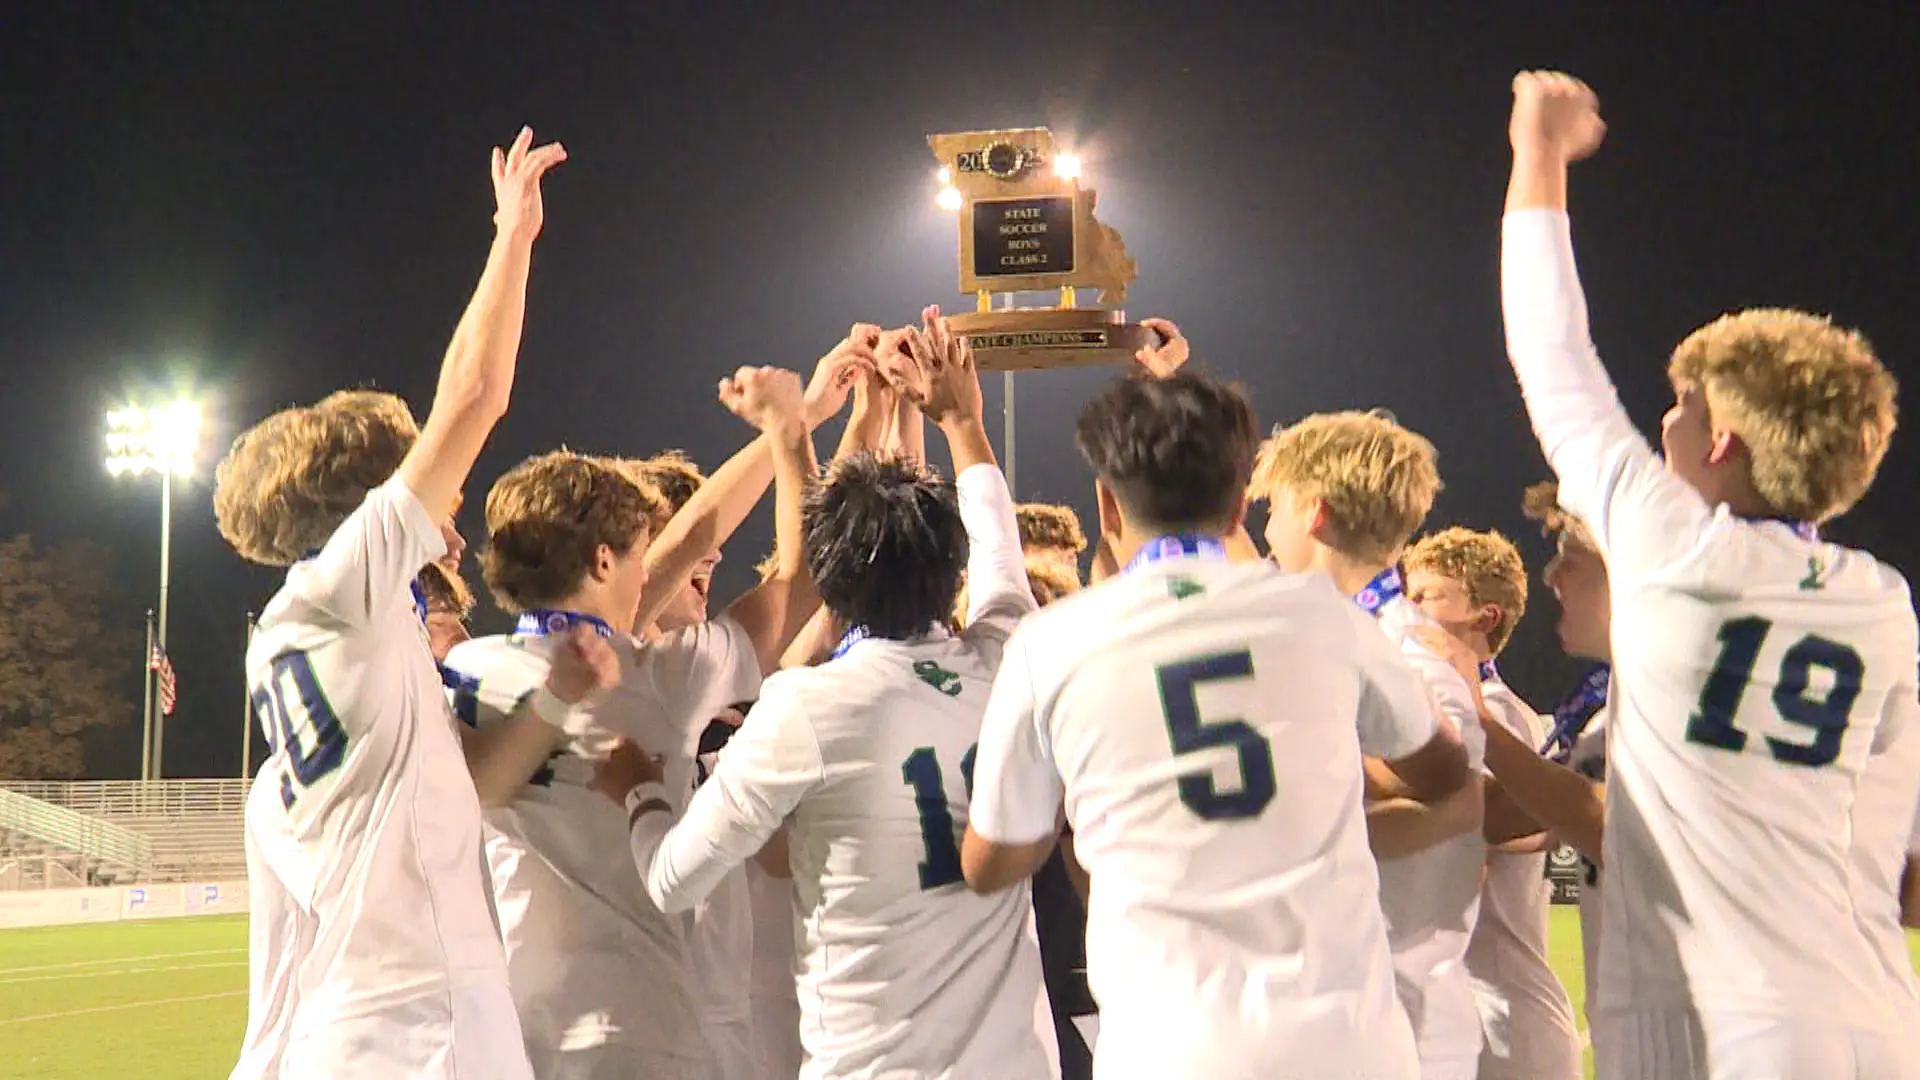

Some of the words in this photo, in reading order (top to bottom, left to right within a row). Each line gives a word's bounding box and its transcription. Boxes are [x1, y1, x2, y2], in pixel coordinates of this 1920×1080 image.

[1004, 208, 1041, 219] STATE
[999, 223, 1048, 235] SOCCER
[1007, 240, 1041, 250] BOYS
[970, 334, 1000, 348] ATE
[1003, 332, 1084, 346] CHAMPIONS
[1687, 615, 1865, 767] 19
[1155, 649, 1278, 821] 5
[902, 742, 979, 890] 1
